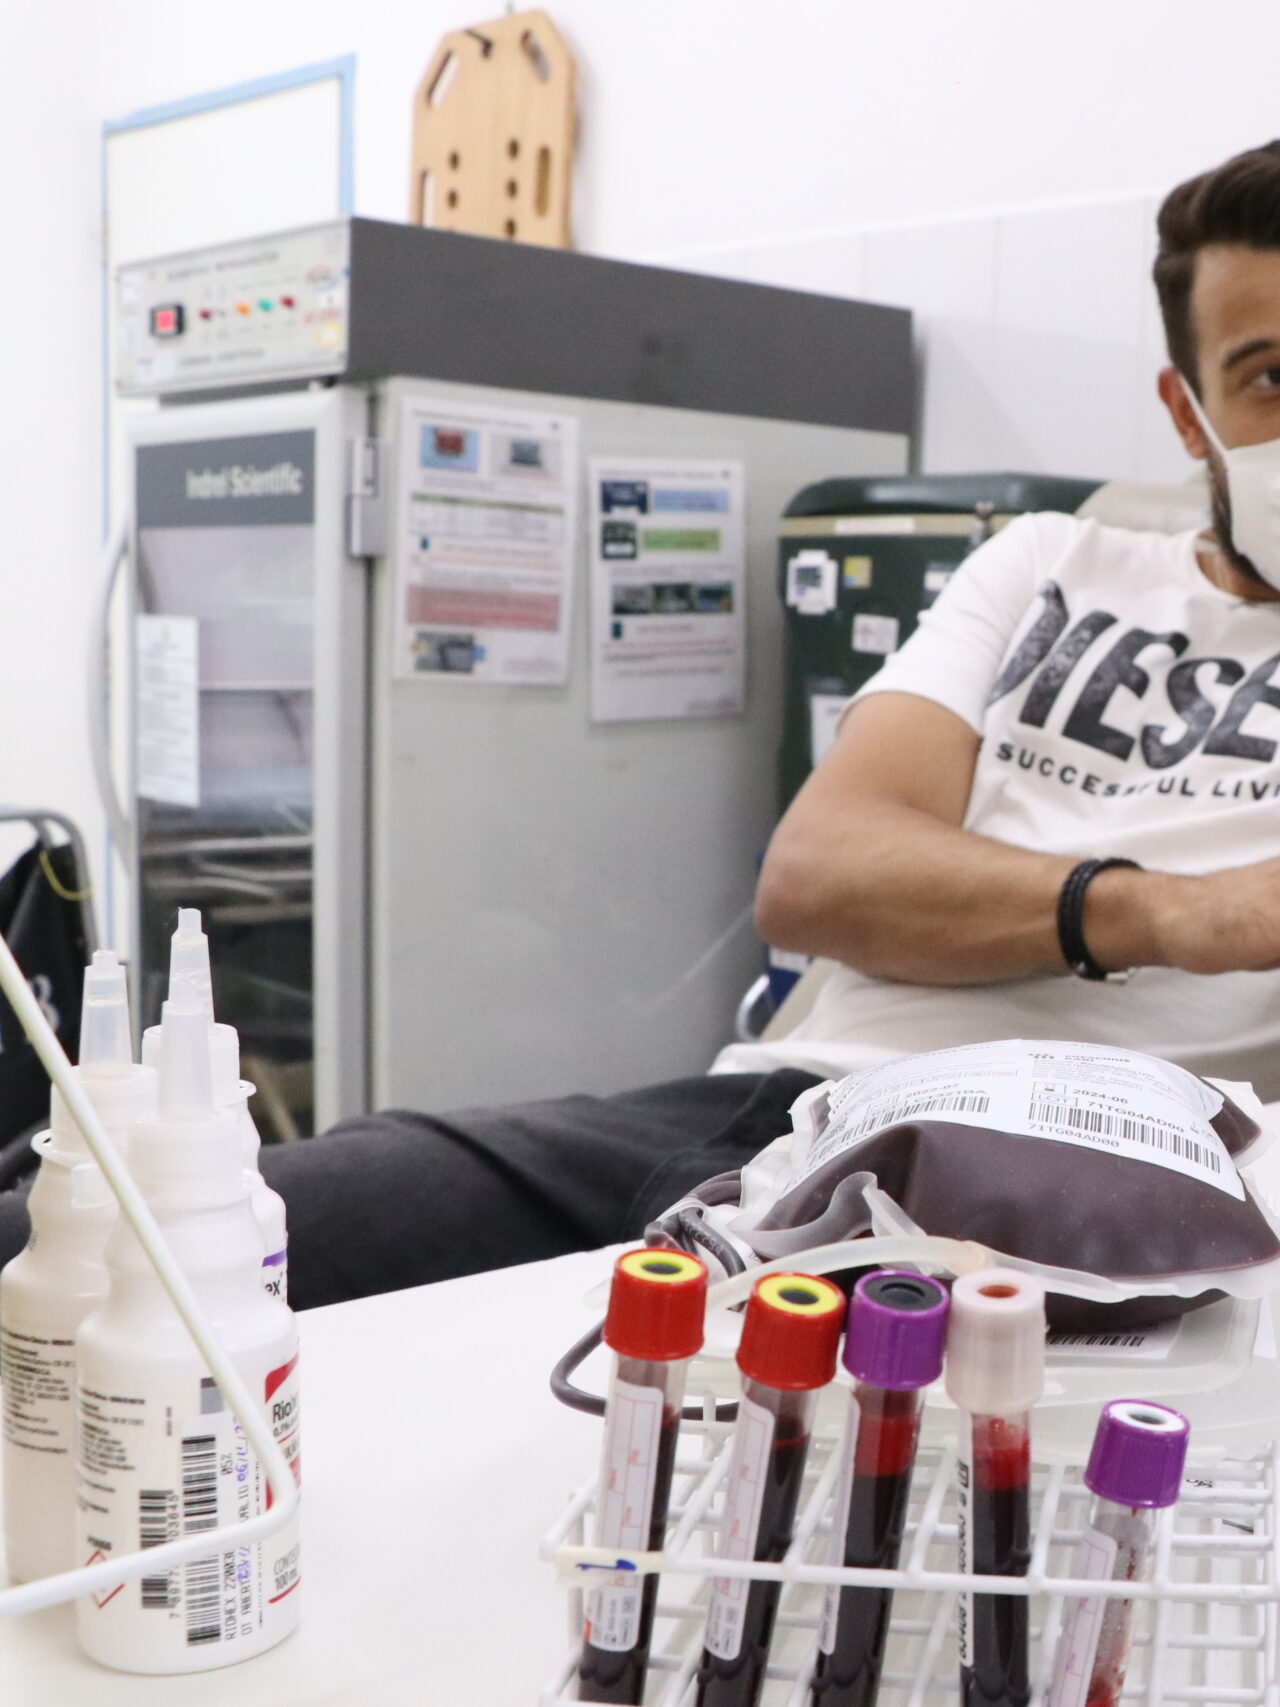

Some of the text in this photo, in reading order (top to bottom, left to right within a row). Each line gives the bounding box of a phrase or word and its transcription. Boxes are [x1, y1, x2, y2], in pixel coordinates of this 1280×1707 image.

[230, 462, 302, 498] Scientific
[1073, 1088, 1129, 1105] 2024-06
[1087, 1100, 1185, 1133] 71TG04AD00
[1028, 1124, 1120, 1148] 71TG04AD00
